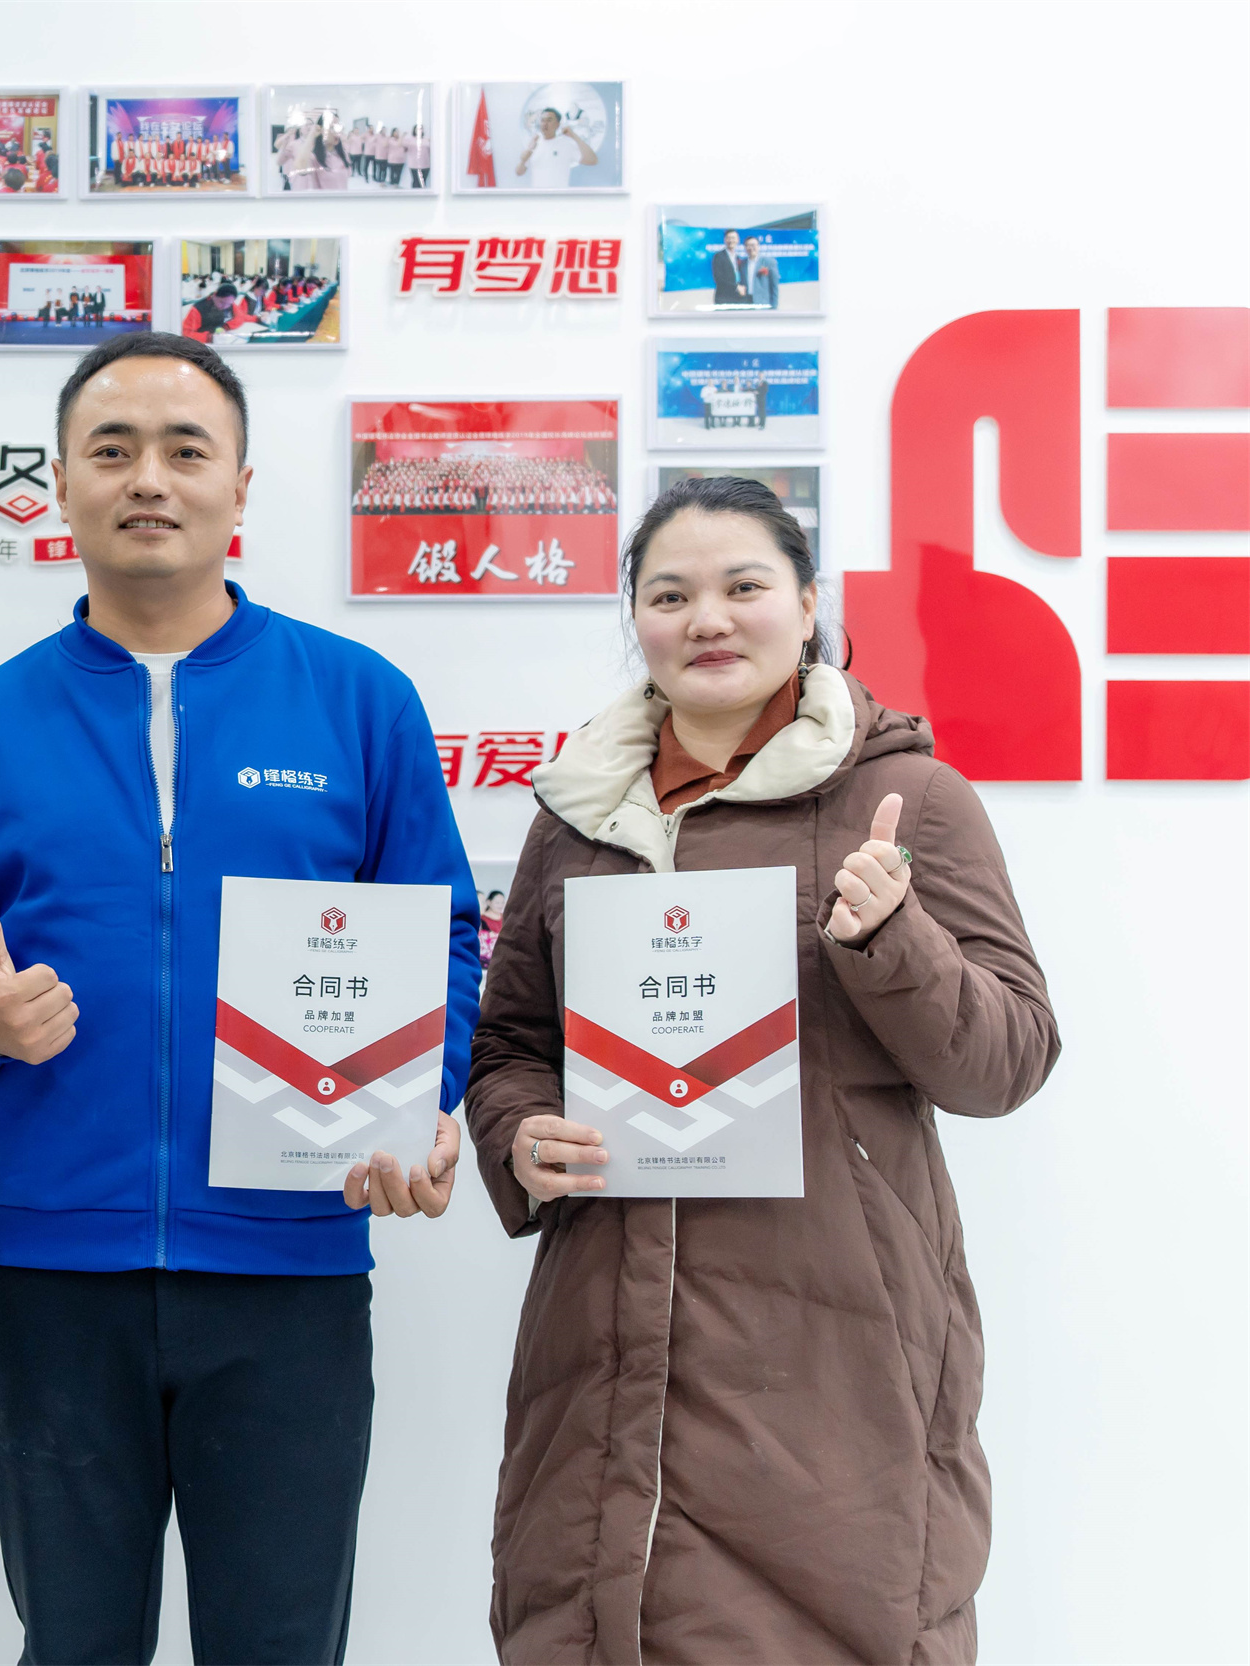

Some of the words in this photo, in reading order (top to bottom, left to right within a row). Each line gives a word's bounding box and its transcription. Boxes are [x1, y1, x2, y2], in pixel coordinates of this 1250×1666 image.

[399, 237, 623, 296] 有梦想
[47, 540, 81, 558] 锋
[406, 537, 576, 586] 锻人格
[263, 768, 328, 788] 锋格练字
[307, 936, 358, 950] 锋格练字
[651, 936, 703, 949] 锋格练字
[292, 974, 369, 999] 合同书
[638, 974, 716, 999] 合同书
[304, 1010, 355, 1022] 品牌加盟
[652, 1010, 704, 1022] 品牌加盟
[303, 1025, 355, 1034] COOPERATE
[652, 1025, 704, 1035] COOPERATE
